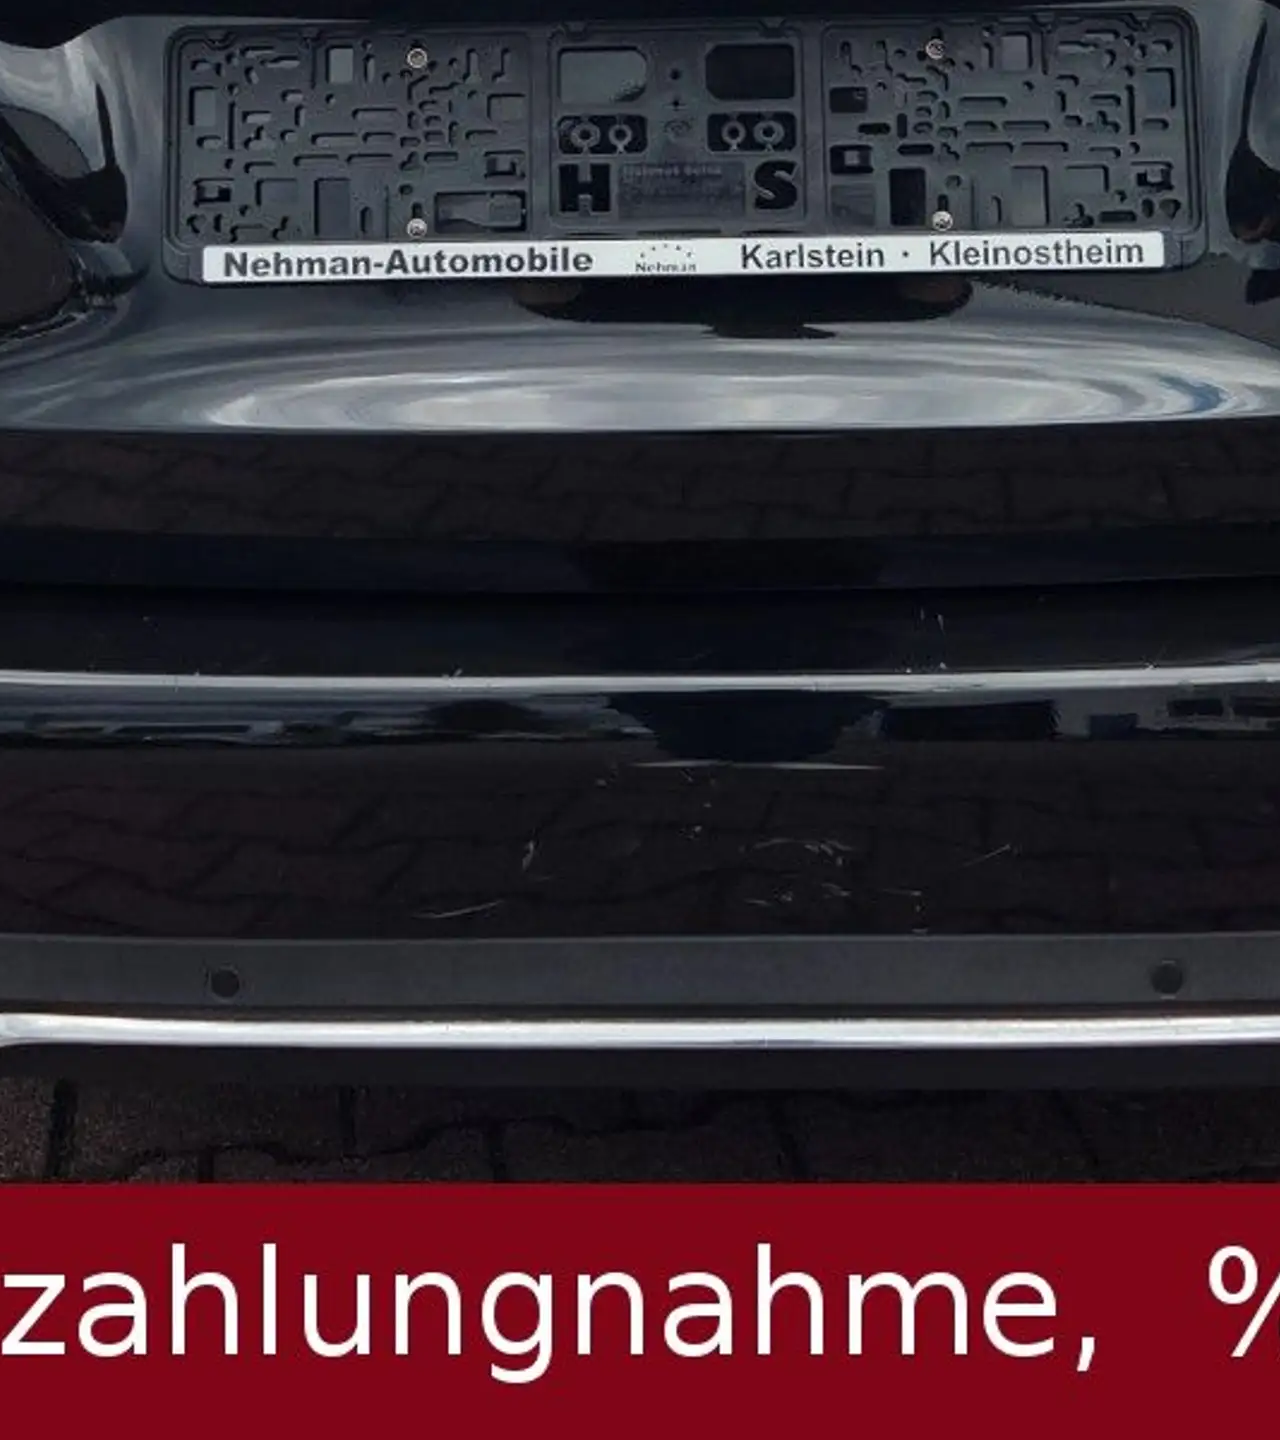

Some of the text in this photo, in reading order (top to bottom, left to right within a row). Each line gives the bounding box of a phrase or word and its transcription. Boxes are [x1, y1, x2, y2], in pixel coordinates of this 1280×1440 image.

[558, 162, 612, 213] H
[753, 161, 798, 210] S
[222, 246, 594, 278] Nehman-Automobile
[635, 261, 697, 273] Nehman
[741, 237, 1145, 270] Karlstein Kleinostheim
